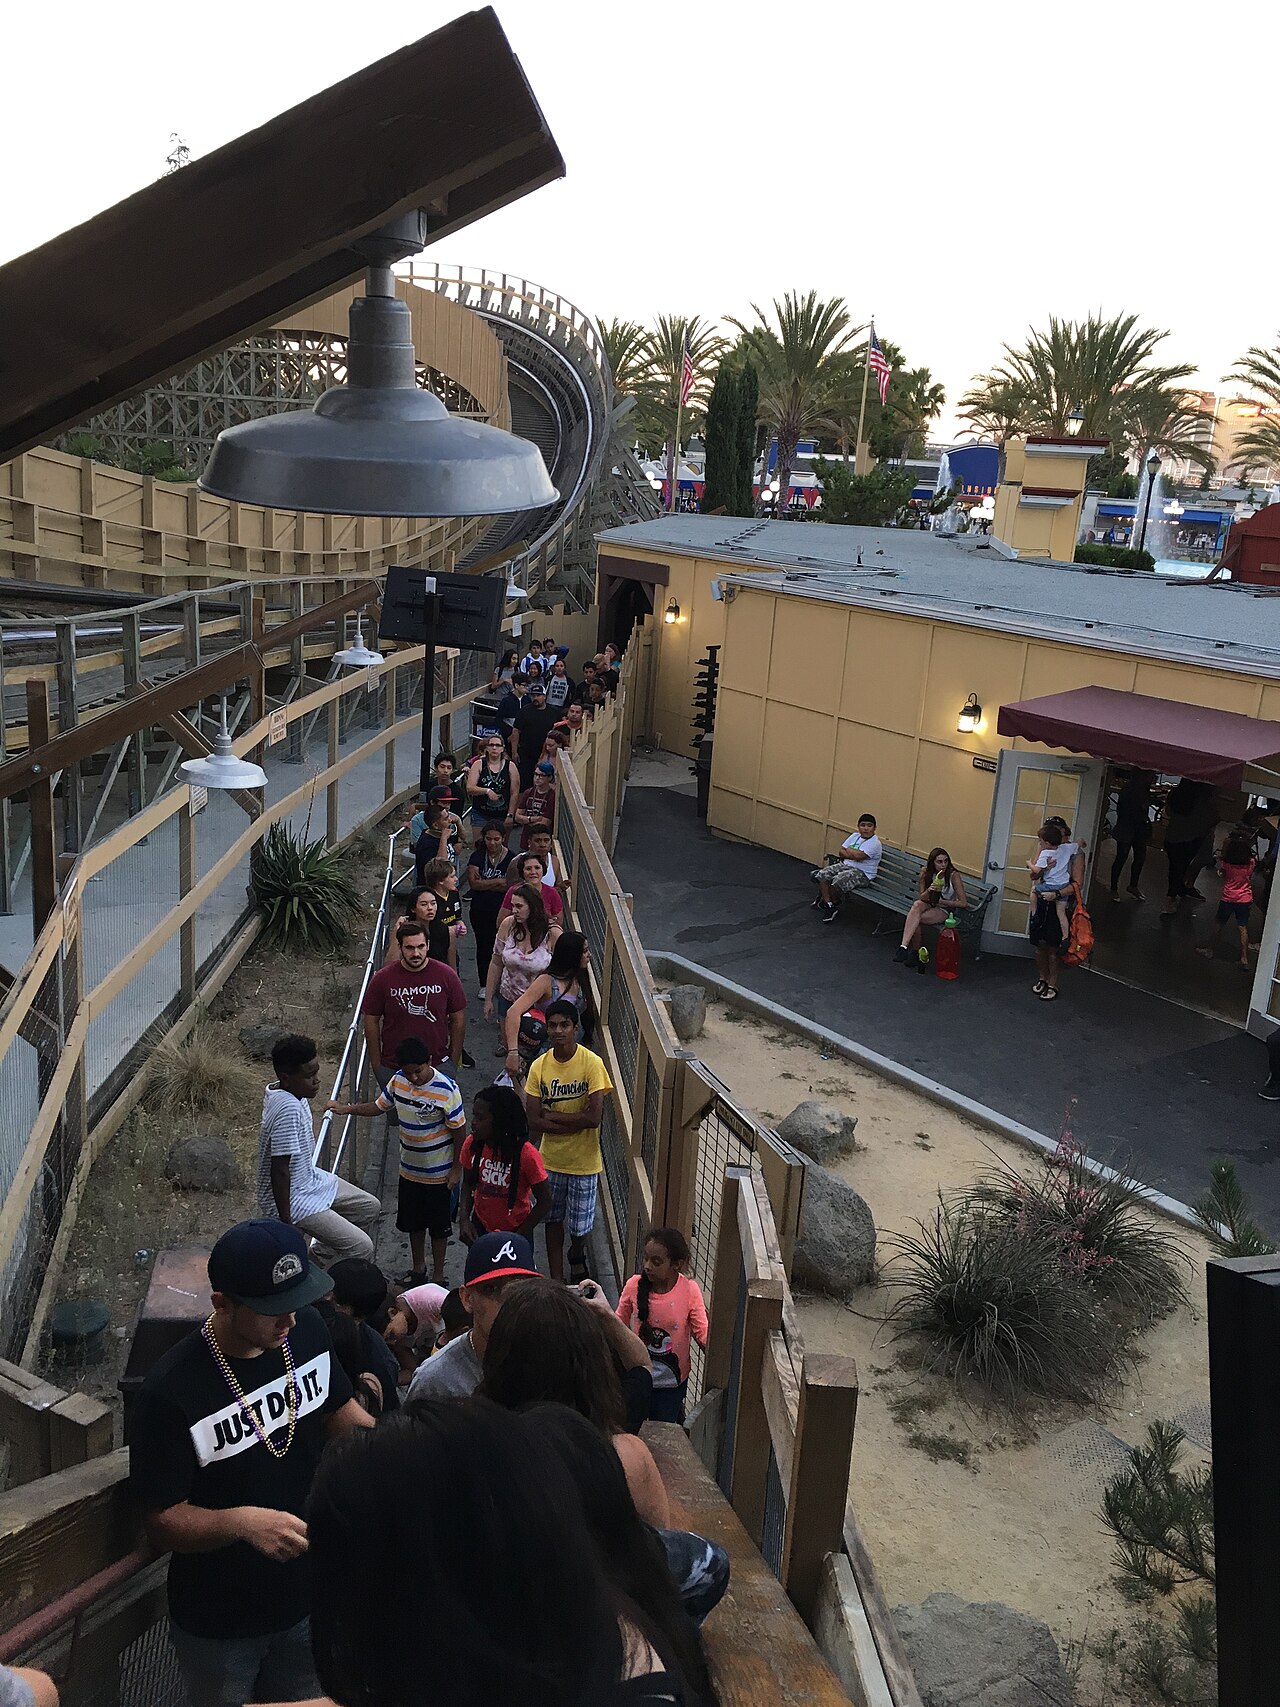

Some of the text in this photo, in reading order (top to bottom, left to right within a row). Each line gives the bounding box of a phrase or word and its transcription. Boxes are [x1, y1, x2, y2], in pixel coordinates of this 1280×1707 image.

[390, 984, 442, 997] DIAMOND
[491, 1240, 517, 1263] A
[213, 1368, 323, 1452] JUST DO IT.
